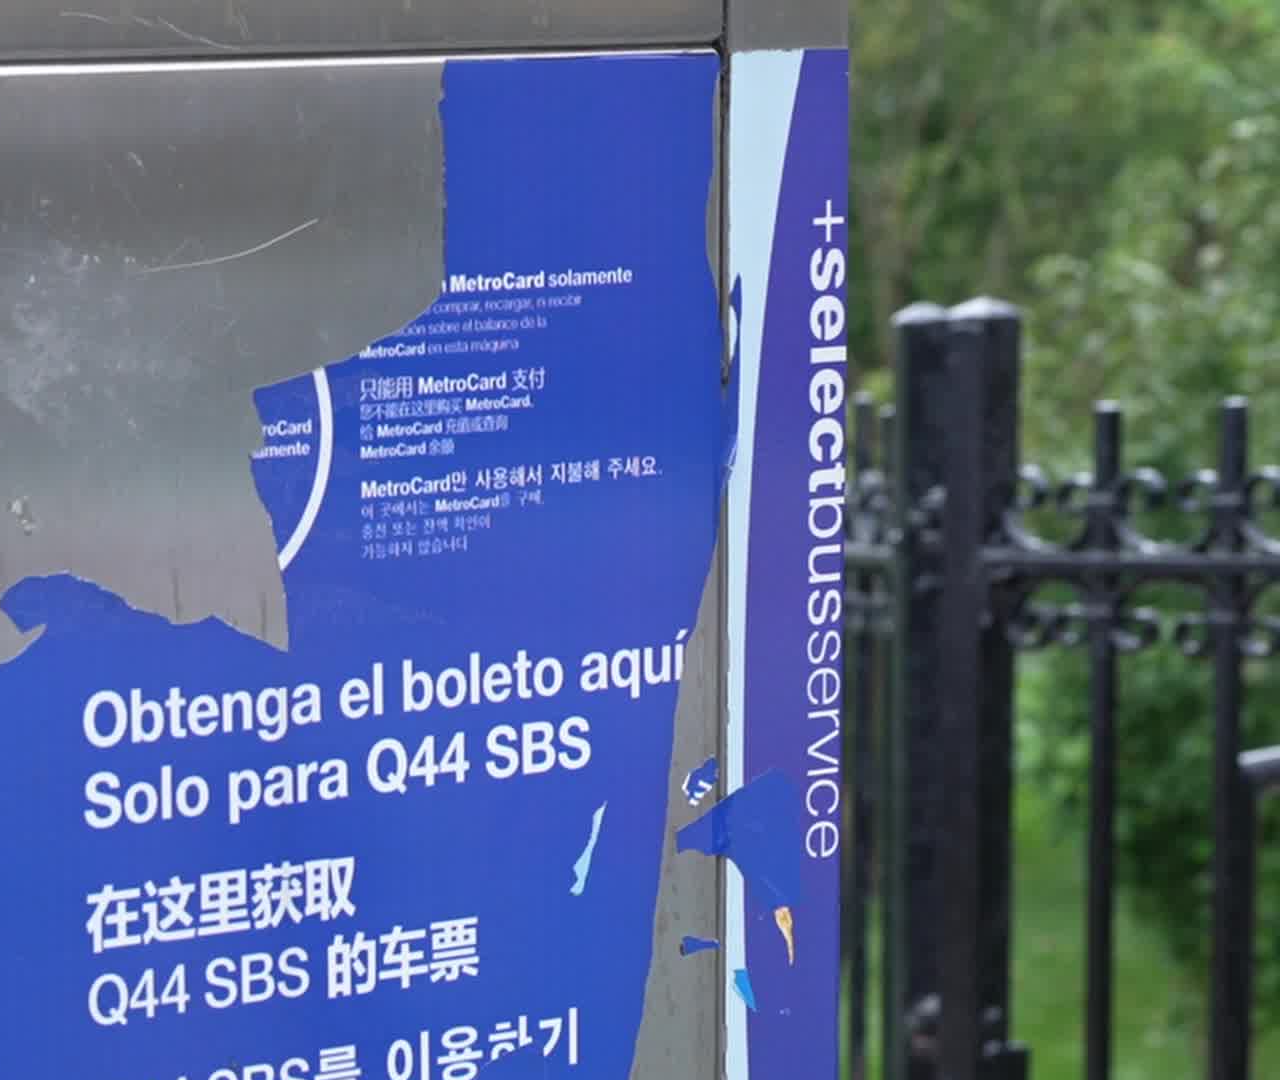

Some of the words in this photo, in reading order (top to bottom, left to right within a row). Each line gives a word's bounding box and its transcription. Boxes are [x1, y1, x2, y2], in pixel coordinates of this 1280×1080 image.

[450, 270, 544, 294] MetroCard
[548, 267, 632, 289] solamente
[418, 372, 506, 396] MetroCard
[512, 366, 546, 392] 支付
[360, 441, 426, 460] MetroCard
[377, 420, 442, 438] MetroCard
[82, 681, 321, 748] Obtenga
[339, 662, 384, 719] el
[402, 651, 564, 714] boleto
[580, 629, 688, 699] aquí
[83, 765, 209, 829] Solo
[228, 756, 349, 825] para
[366, 731, 470, 794] Q44
[485, 716, 591, 779] SBS
[85, 855, 357, 954] 在这里获取
[87, 963, 190, 1026] Q44
[204, 946, 310, 1009] SBS
[327, 916, 480, 999] 的车票
